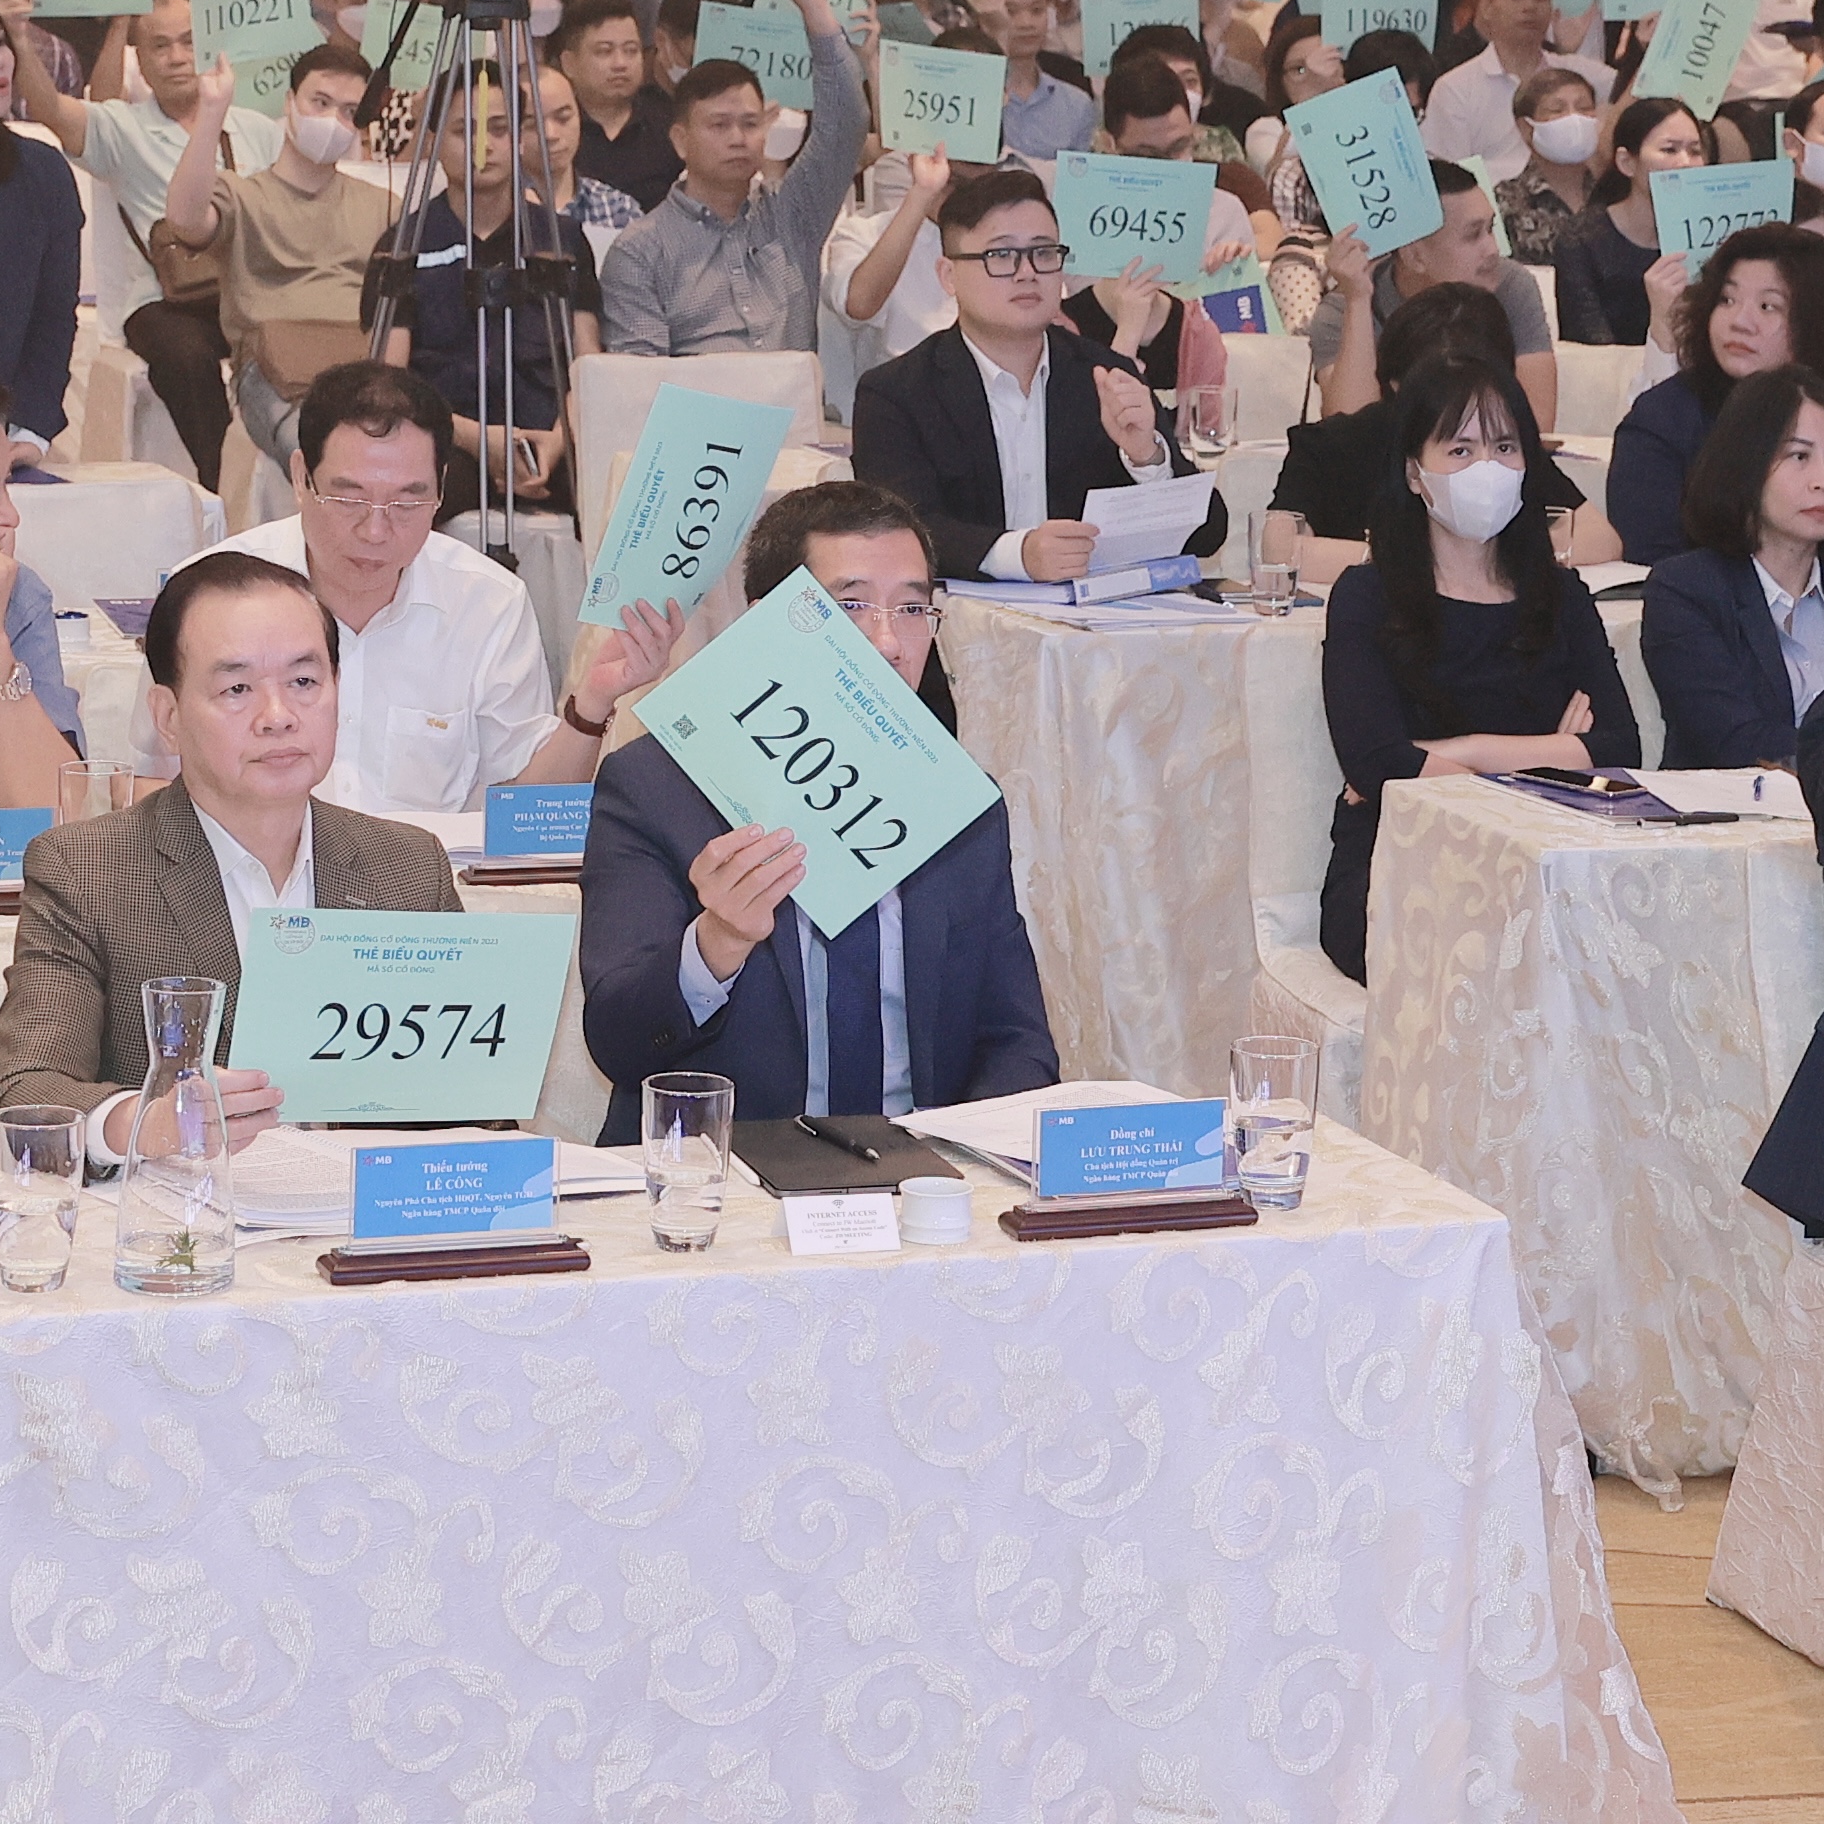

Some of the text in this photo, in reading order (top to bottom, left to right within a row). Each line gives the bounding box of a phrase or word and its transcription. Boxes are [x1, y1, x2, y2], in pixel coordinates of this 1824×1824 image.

[1681, 2, 1725, 80] 10047
[731, 45, 813, 80] 72180
[904, 89, 974, 126] 25951
[1336, 126, 1396, 229] 31528
[1089, 206, 1186, 243] 69455
[662, 443, 742, 579] 86391
[592, 577, 604, 595] MB
[812, 600, 833, 622] MB
[834, 668, 909, 750] THẺ BIỂU QUYẾT
[729, 677, 908, 871] 120312
[536, 799, 562, 808] Trung
[514, 812, 582, 822] PHẠM QUANG
[288, 916, 310, 928] MB
[353, 946, 463, 961] THẺ BIỂU QUYẾT
[310, 1003, 505, 1060] 29574
[1058, 1117, 1074, 1126] MB
[1110, 1127, 1154, 1141] Đồng chí
[1080, 1140, 1182, 1159] LƯU TRUNG THÁI
[375, 1155, 392, 1166] MB
[422, 1160, 488, 1174] Thiếu tướng
[426, 1176, 483, 1191] LÊ CÔNG
